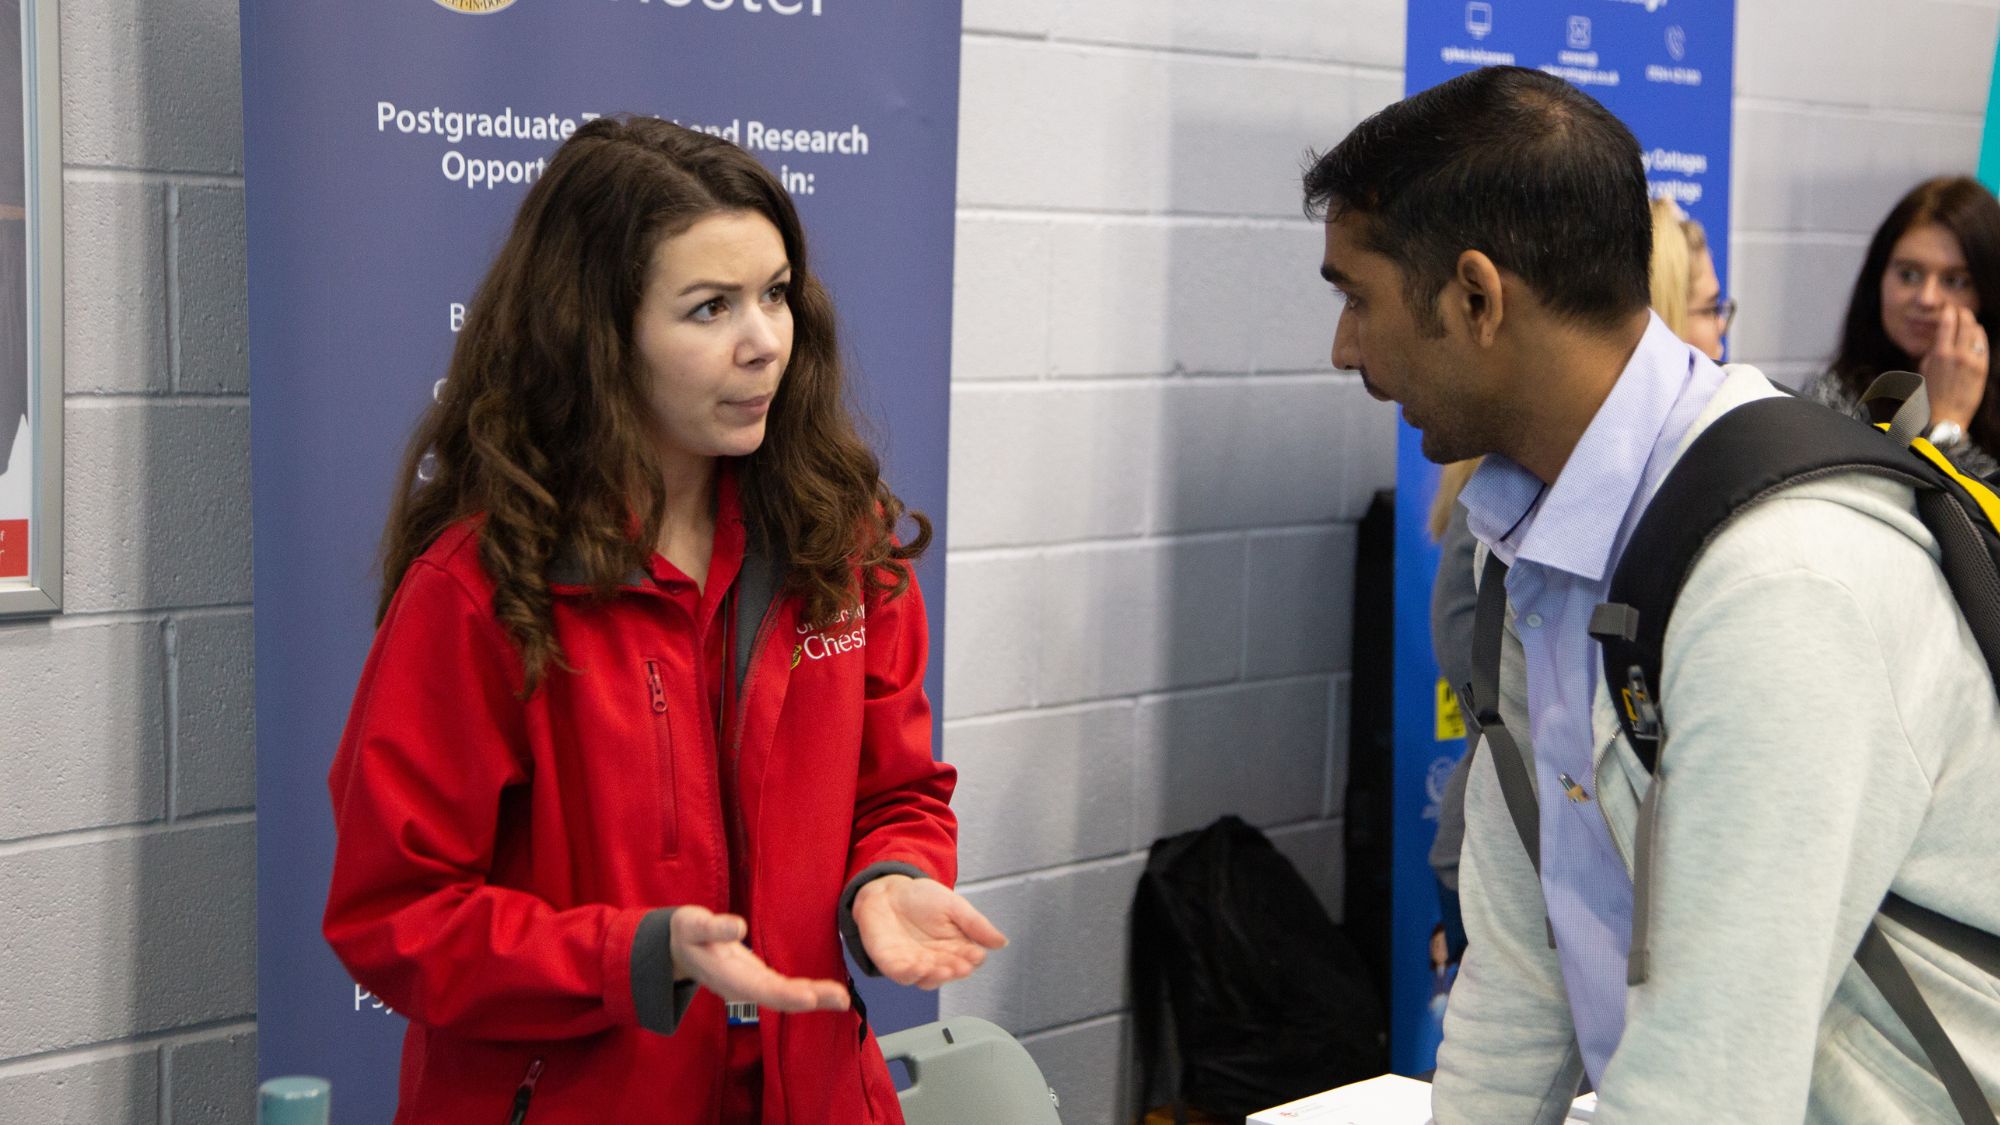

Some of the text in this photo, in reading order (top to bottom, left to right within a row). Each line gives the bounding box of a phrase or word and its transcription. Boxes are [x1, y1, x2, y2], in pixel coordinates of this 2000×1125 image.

[377, 101, 577, 143] Postgraduate
[747, 120, 869, 155] Research
[781, 164, 815, 195] in:
